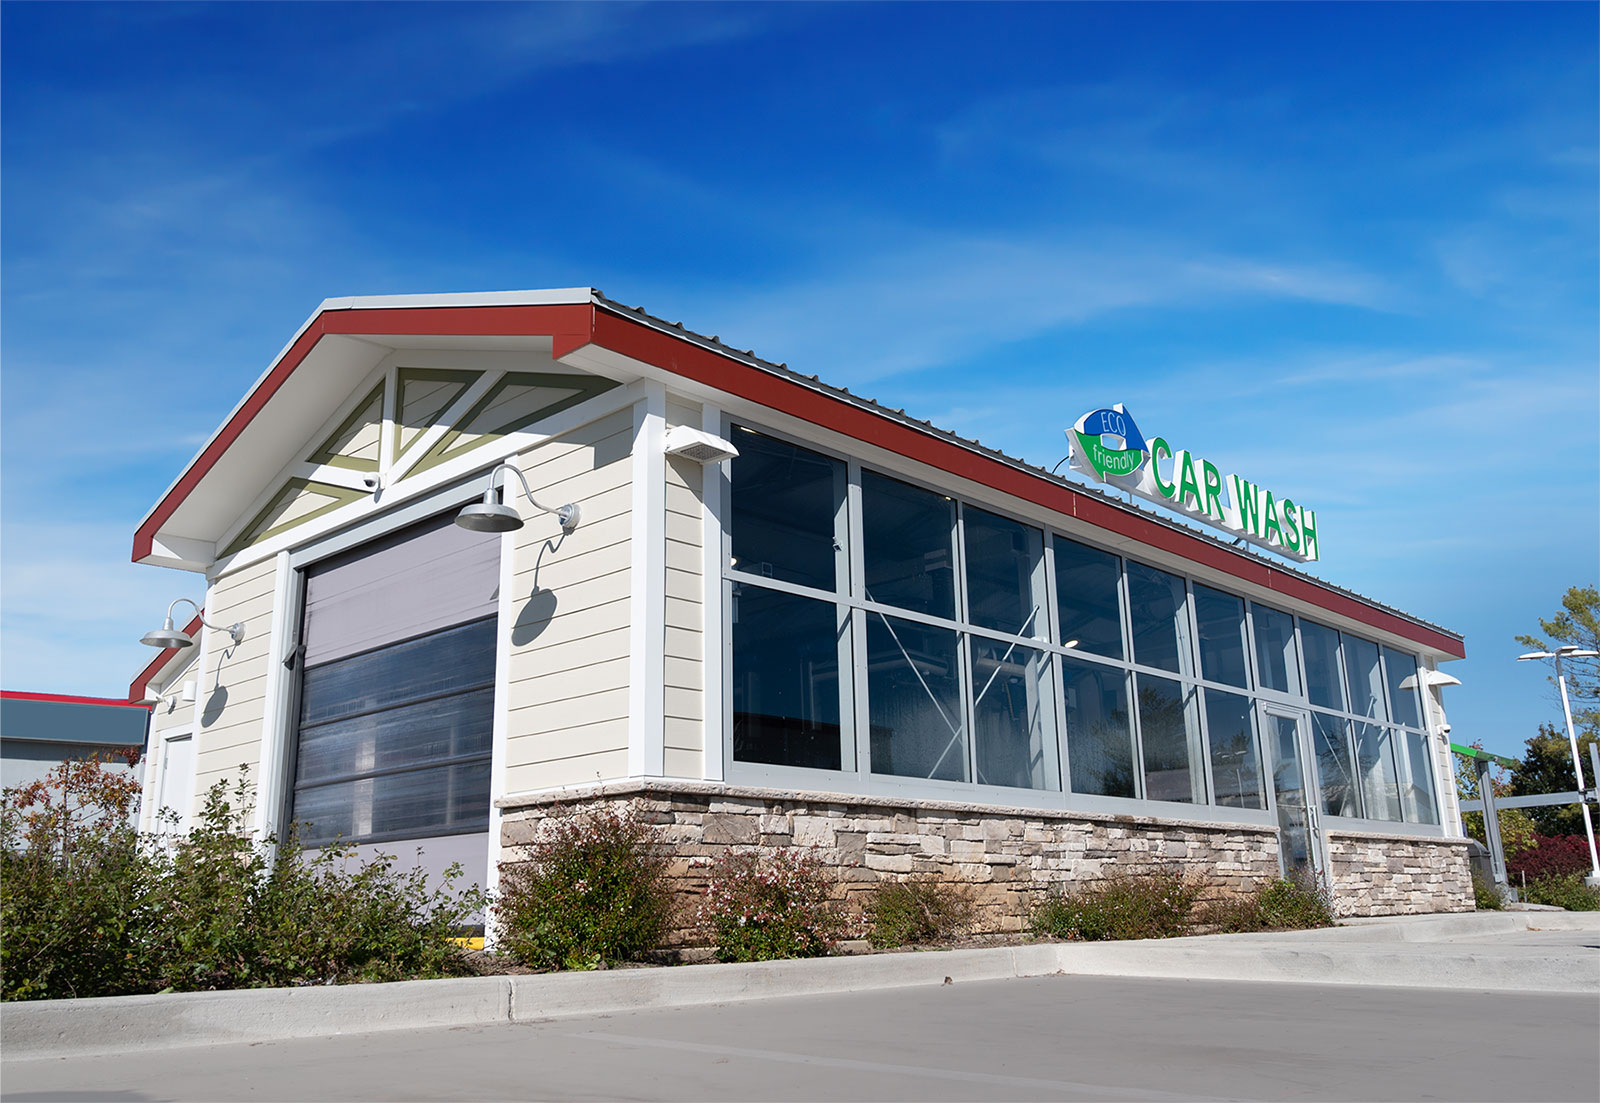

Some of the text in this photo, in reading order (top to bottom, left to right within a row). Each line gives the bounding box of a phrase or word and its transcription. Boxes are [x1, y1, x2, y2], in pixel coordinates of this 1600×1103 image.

[1101, 412, 1126, 436] ECO
[1093, 444, 1134, 471] friendly
[1152, 437, 1319, 561] CAR WASH
